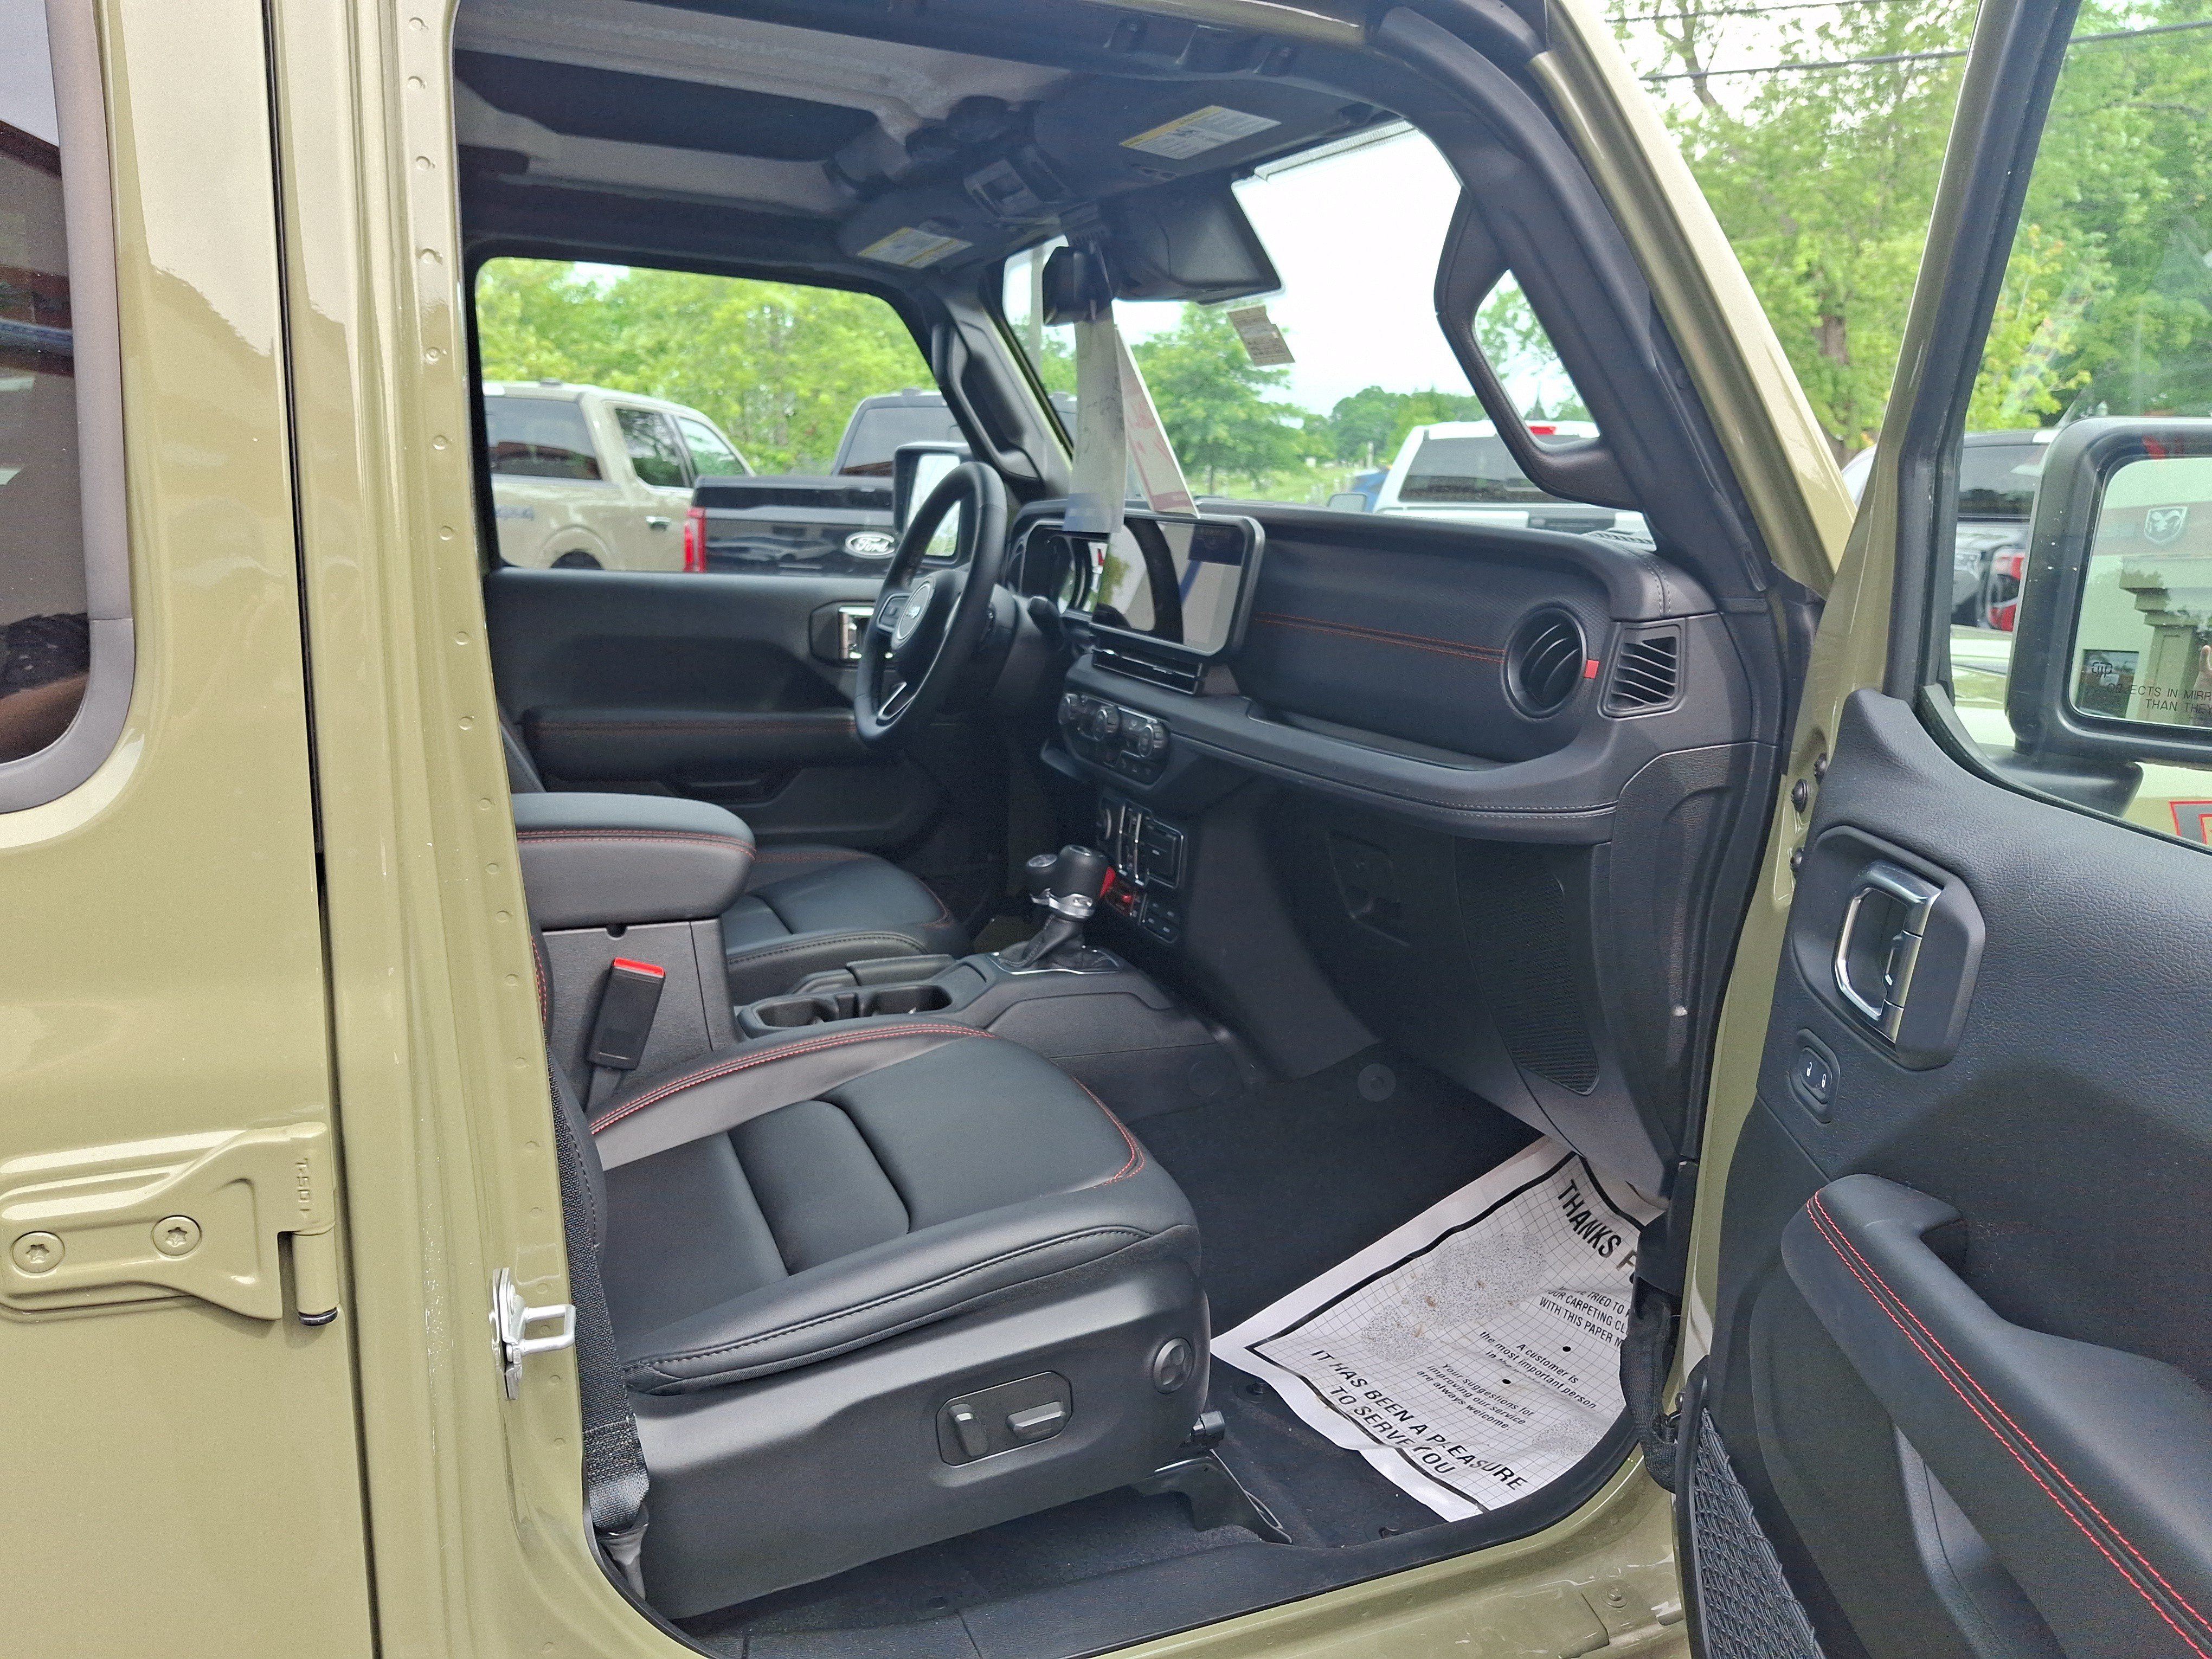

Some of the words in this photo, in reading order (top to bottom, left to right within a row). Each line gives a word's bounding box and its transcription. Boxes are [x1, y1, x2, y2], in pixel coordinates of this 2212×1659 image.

[856, 536, 890, 552] Ford
[2107, 683, 2162, 697] OBJECTS
[2167, 688, 2178, 698] IN
[2145, 698, 2178, 711] THAN
[1558, 1179, 1622, 1258] THANKS
[1539, 1296, 1562, 1316] WITH
[1562, 1308, 1583, 1327] THIS
[1584, 1320, 1613, 1343] PAPER
[1565, 1295, 1613, 1326] CARPETING
[1615, 1320, 1628, 1335] CL
[1587, 1291, 1612, 1307] TRIED
[1612, 1301, 1625, 1315] TO
[1480, 1331, 1495, 1343] the
[1495, 1343, 1520, 1361] most
[1518, 1358, 1565, 1390] important
[1560, 1386, 1597, 1409] person
[1486, 1350, 1496, 1359] in
[1517, 1343, 1526, 1352] A
[1525, 1349, 1570, 1378] customer
[1568, 1374, 1579, 1384] is
[1310, 1350, 1335, 1361] IT
[1329, 1362, 1368, 1387] HAS
[1364, 1390, 1415, 1422] BEEN
[1408, 1424, 1429, 1436] A
[1417, 1371, 1433, 1382] are
[1433, 1382, 1466, 1405] always
[1465, 1405, 1509, 1431] welcome.
[1426, 1365, 1473, 1398] improving
[1472, 1397, 1491, 1407] our
[1490, 1405, 1526, 1425] service
[1442, 1364, 1464, 1379] Your
[1463, 1378, 1519, 1410] suggestions
[1518, 1407, 1535, 1417] for
[1330, 1386, 1357, 1405] TO
[1354, 1406, 1417, 1446] SERVE
[1412, 1446, 1457, 1474] YOU
